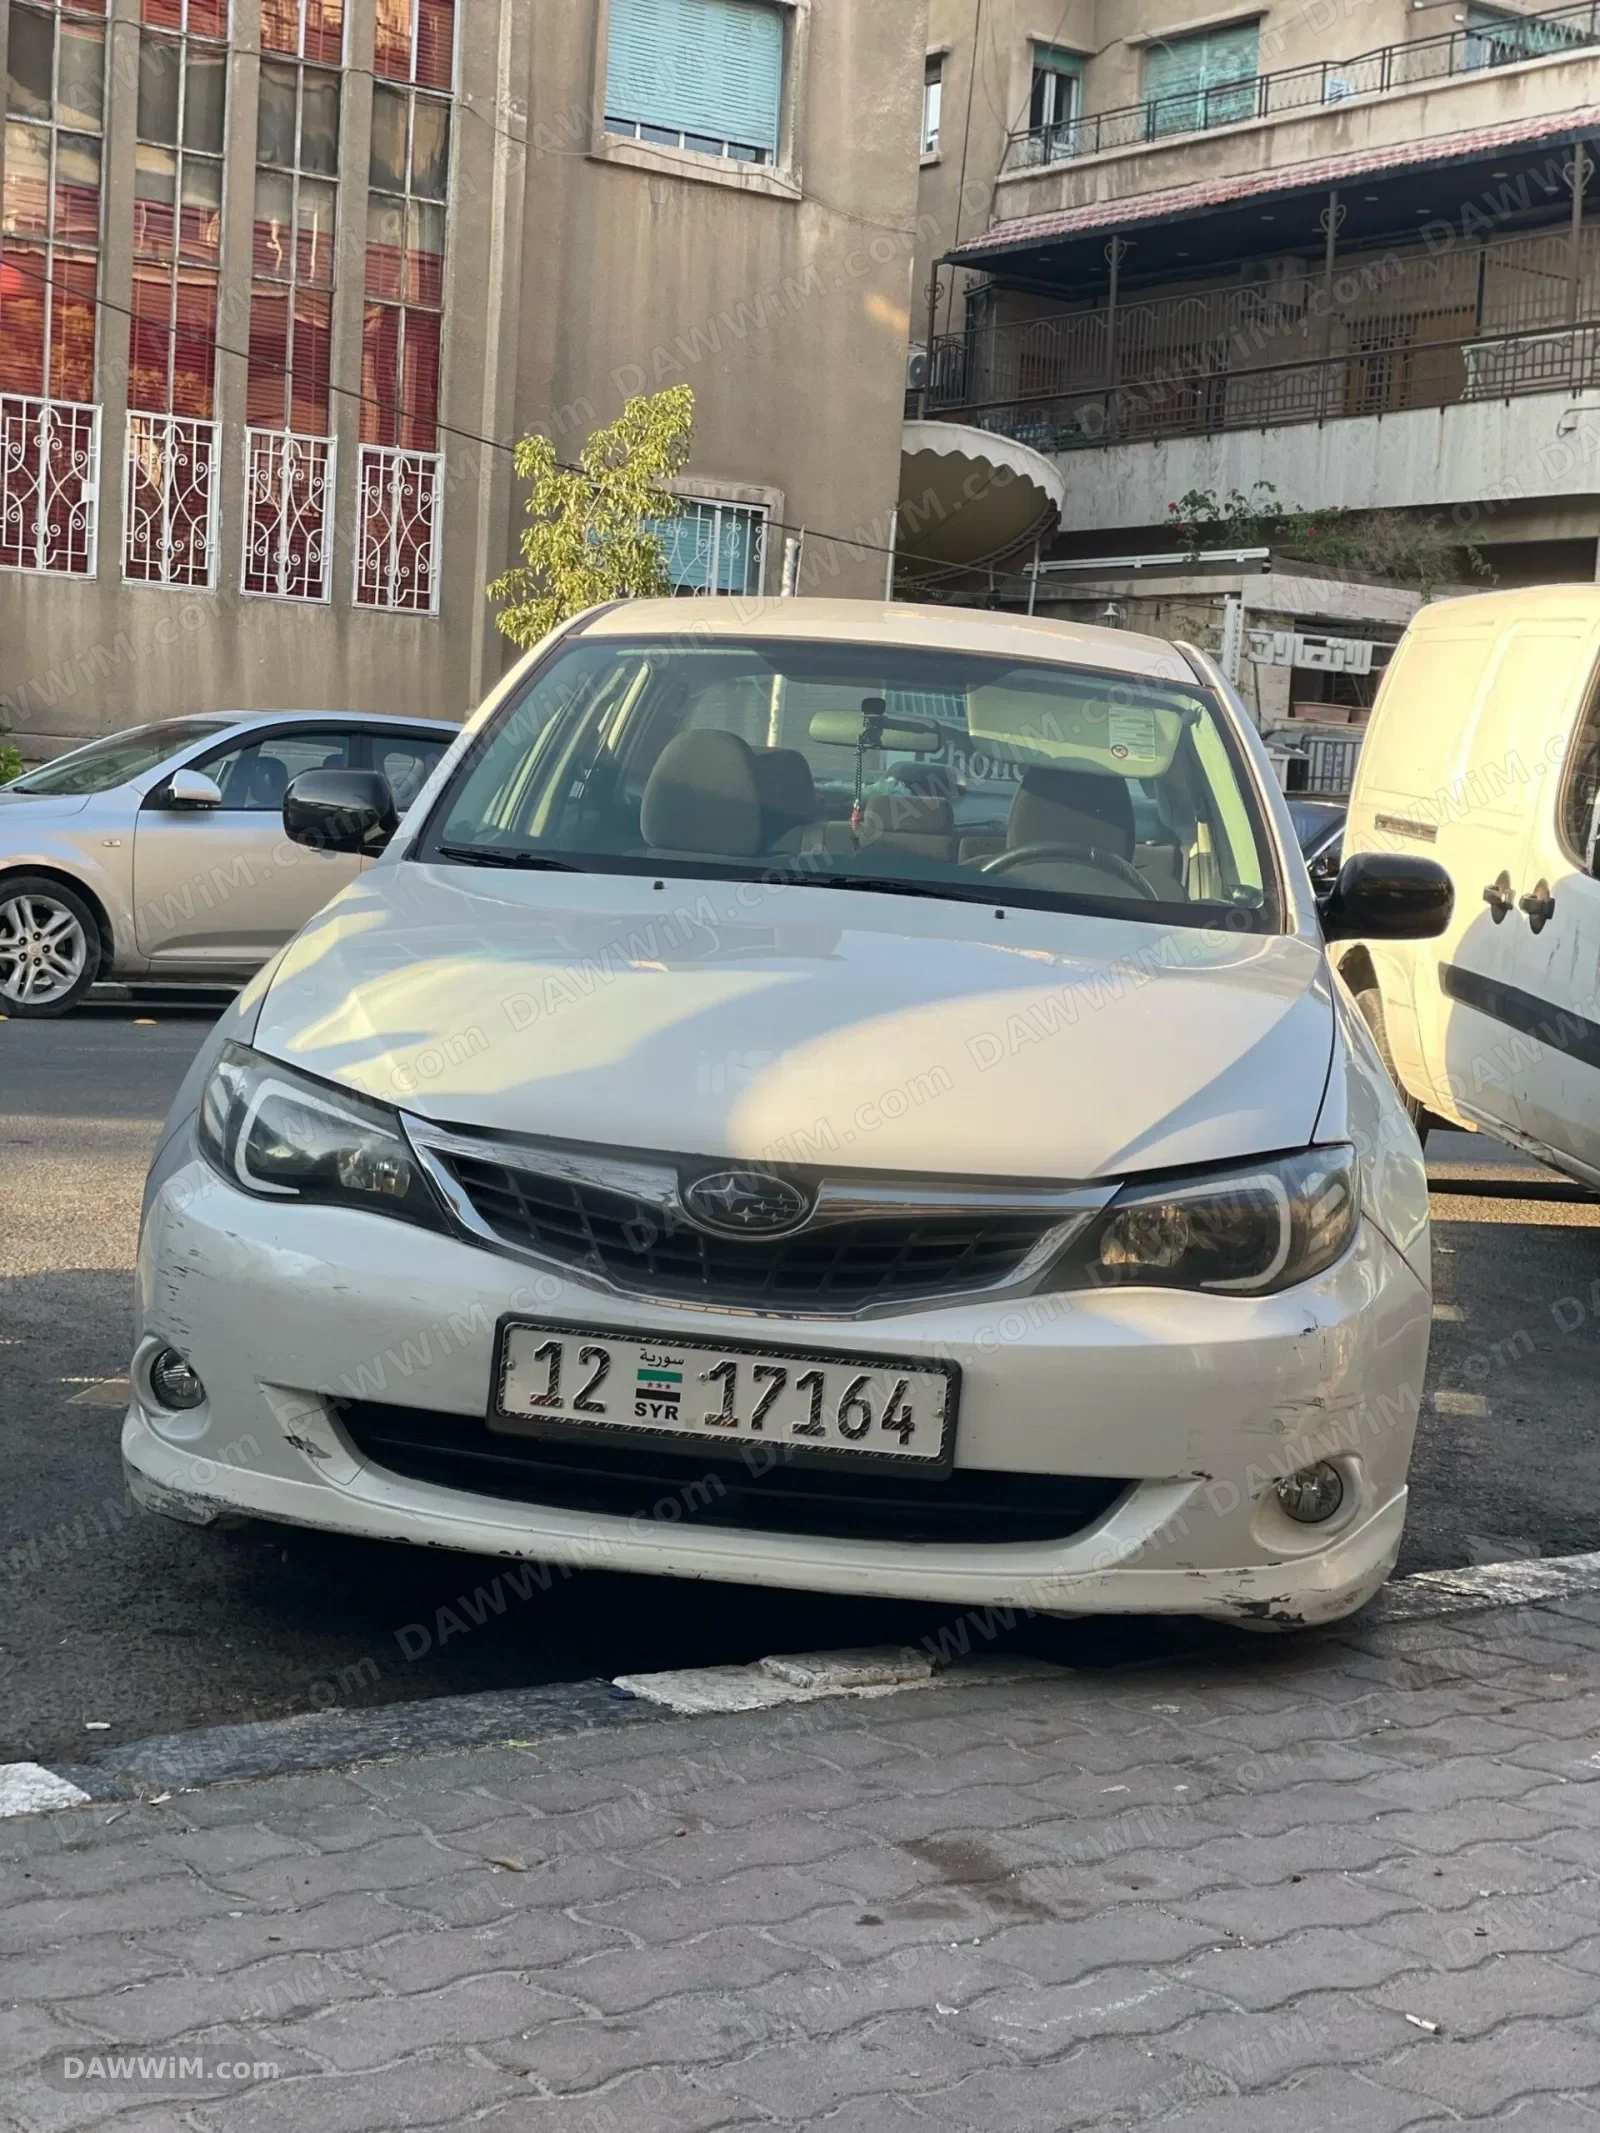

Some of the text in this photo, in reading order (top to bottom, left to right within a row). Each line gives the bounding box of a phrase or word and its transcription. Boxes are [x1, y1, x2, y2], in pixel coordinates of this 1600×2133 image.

[639, 1347, 685, 1368] سورية
[529, 1339, 917, 1446] 12 17164
[634, 1401, 679, 1421] SYR
